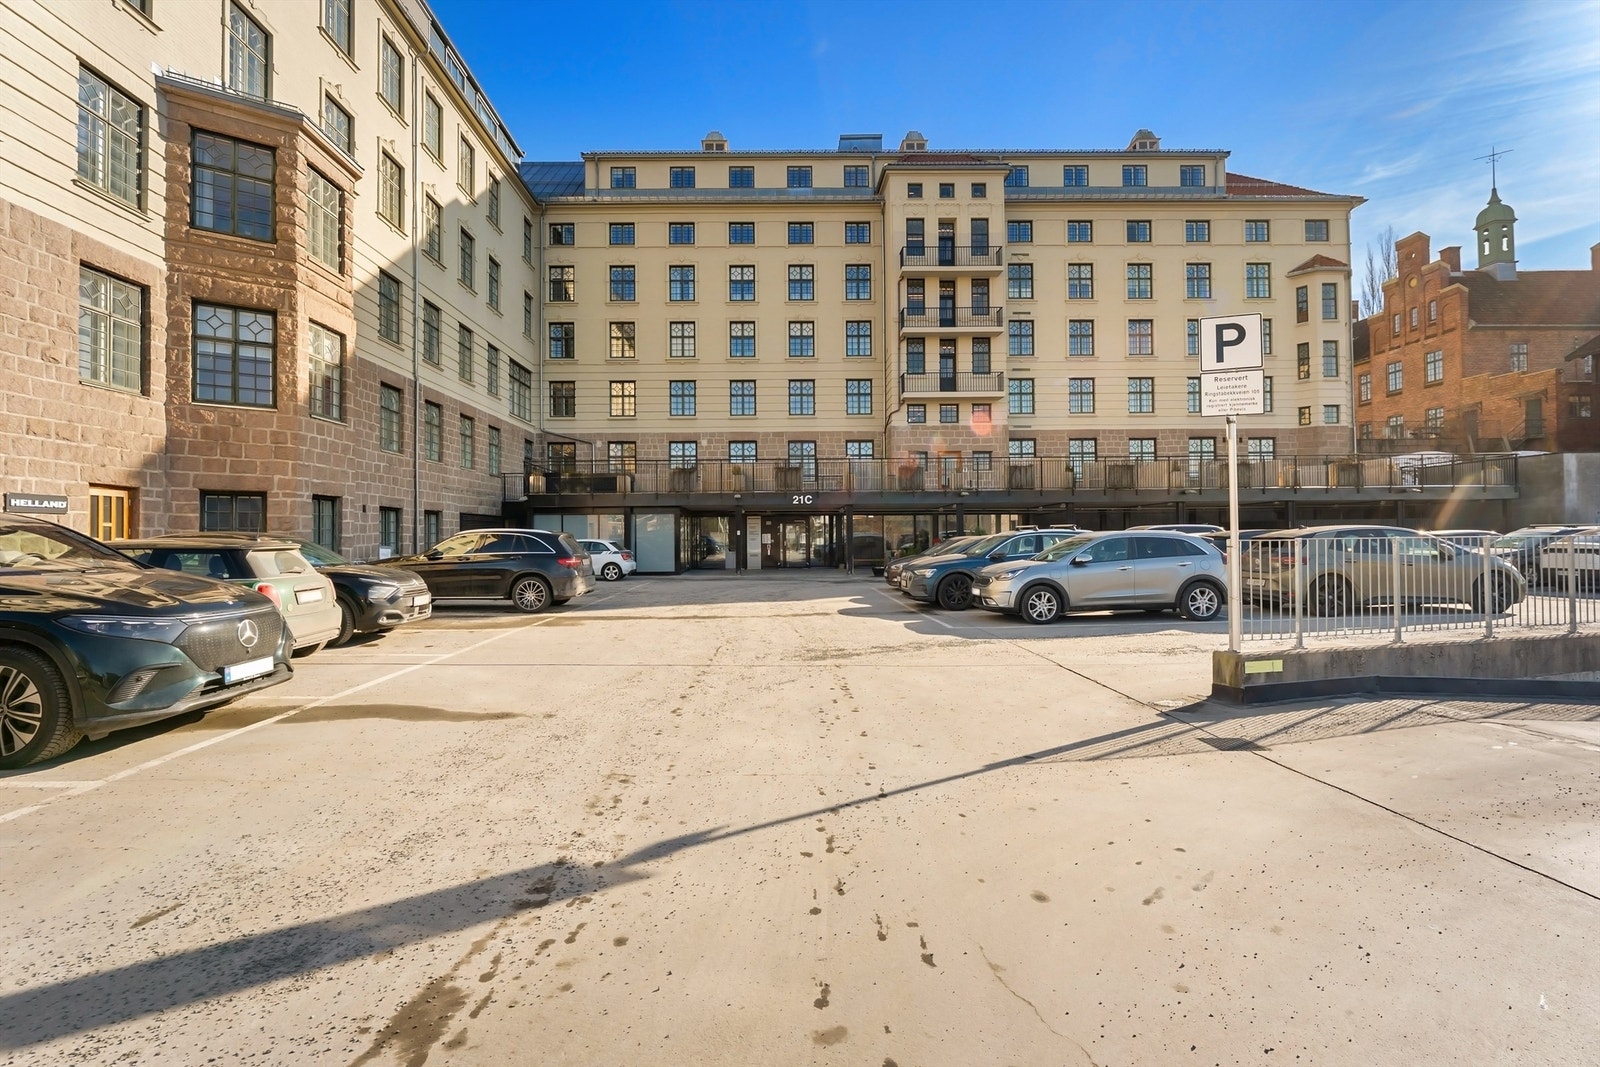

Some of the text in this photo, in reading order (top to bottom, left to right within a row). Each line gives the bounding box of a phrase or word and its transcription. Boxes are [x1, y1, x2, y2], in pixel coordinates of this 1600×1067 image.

[1215, 322, 1246, 363] P
[10, 498, 67, 509] HELLAND
[792, 495, 813, 504] 21C
